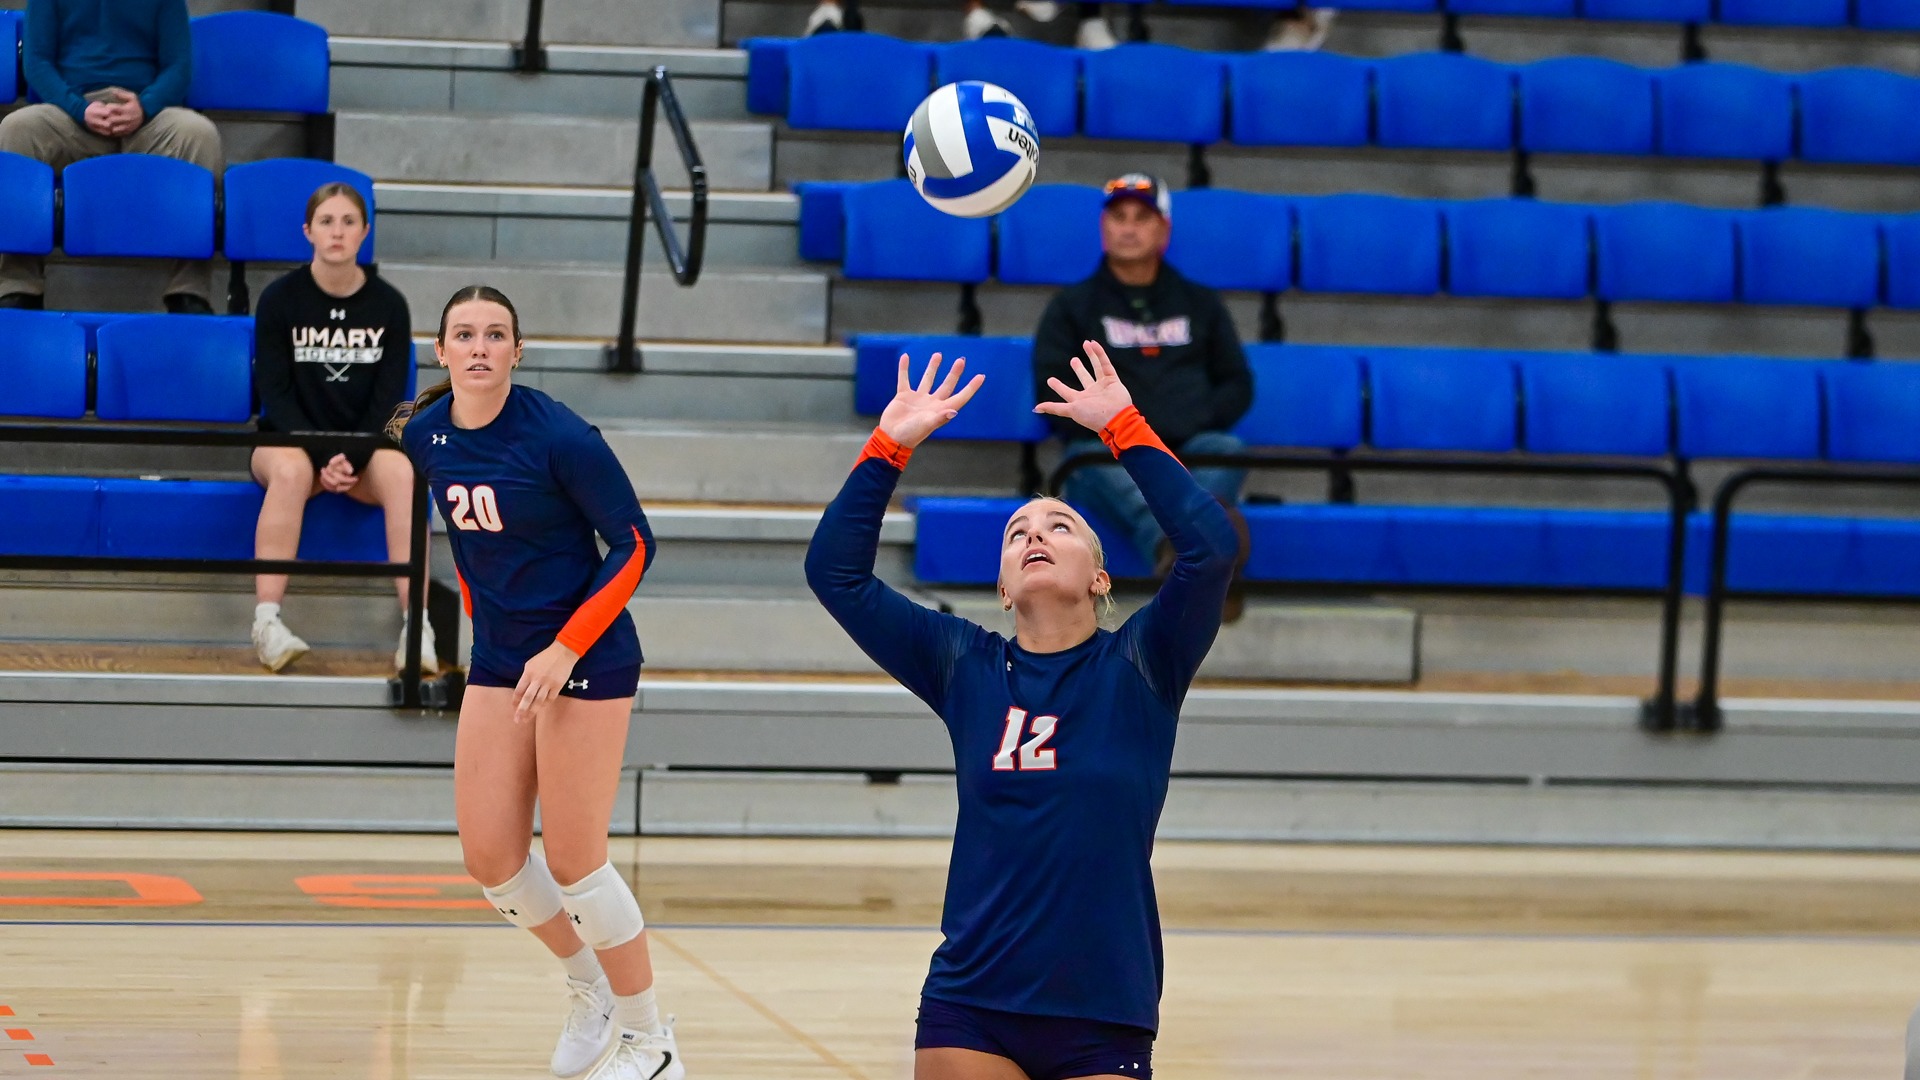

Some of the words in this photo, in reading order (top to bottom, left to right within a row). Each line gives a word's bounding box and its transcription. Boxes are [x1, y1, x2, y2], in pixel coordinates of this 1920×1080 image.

[1008, 127, 1038, 164] olten
[292, 326, 385, 347] UMARY
[446, 483, 504, 532] 20
[992, 705, 1058, 771] 12
